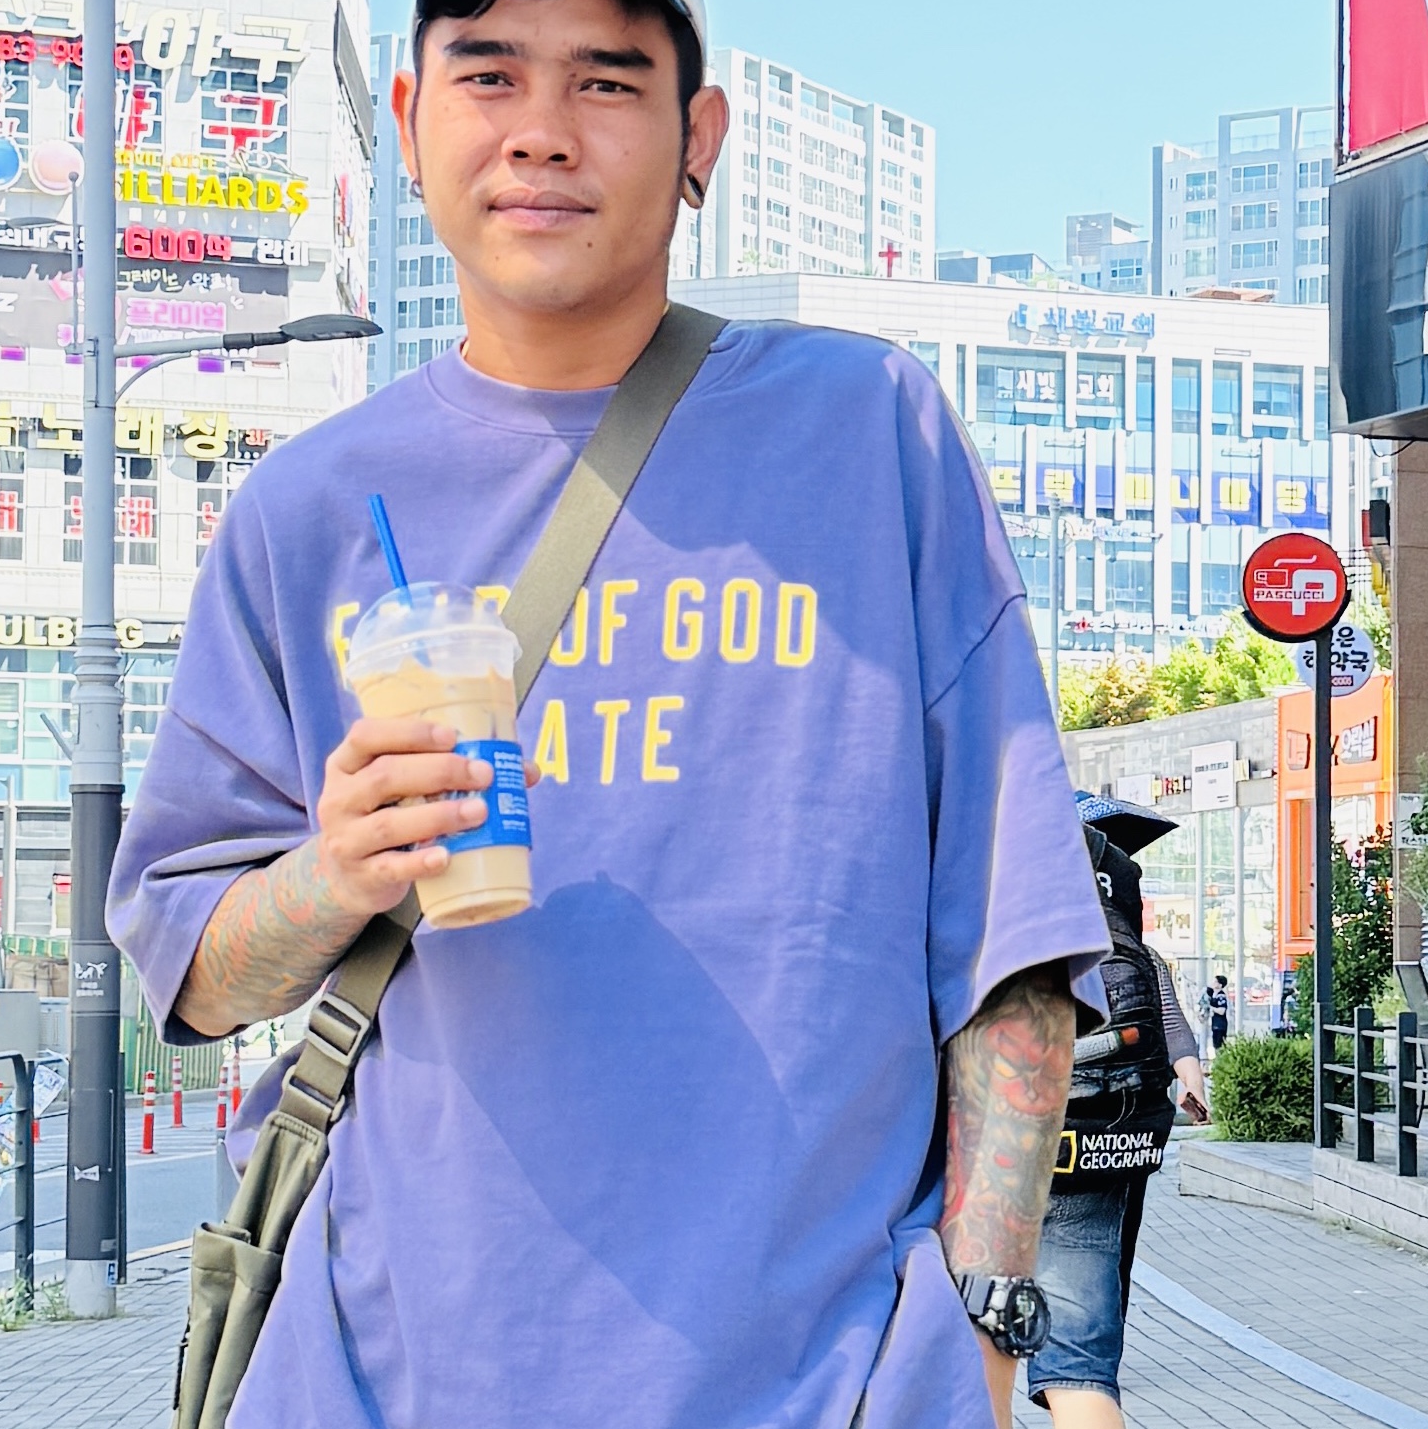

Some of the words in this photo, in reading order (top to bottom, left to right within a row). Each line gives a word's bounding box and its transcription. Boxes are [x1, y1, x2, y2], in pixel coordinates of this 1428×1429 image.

[116, 168, 310, 216] ILLIARDS
[256, 237, 311, 267] 완비
[117, 267, 183, 292] 그레이드
[1254, 589, 1326, 602] PASCUCCI
[662, 577, 818, 668] GOD
[533, 694, 685, 785] ATE
[1081, 1132, 1155, 1153] NATIONAL
[1079, 1147, 1164, 1170] GEOGRAPHI
